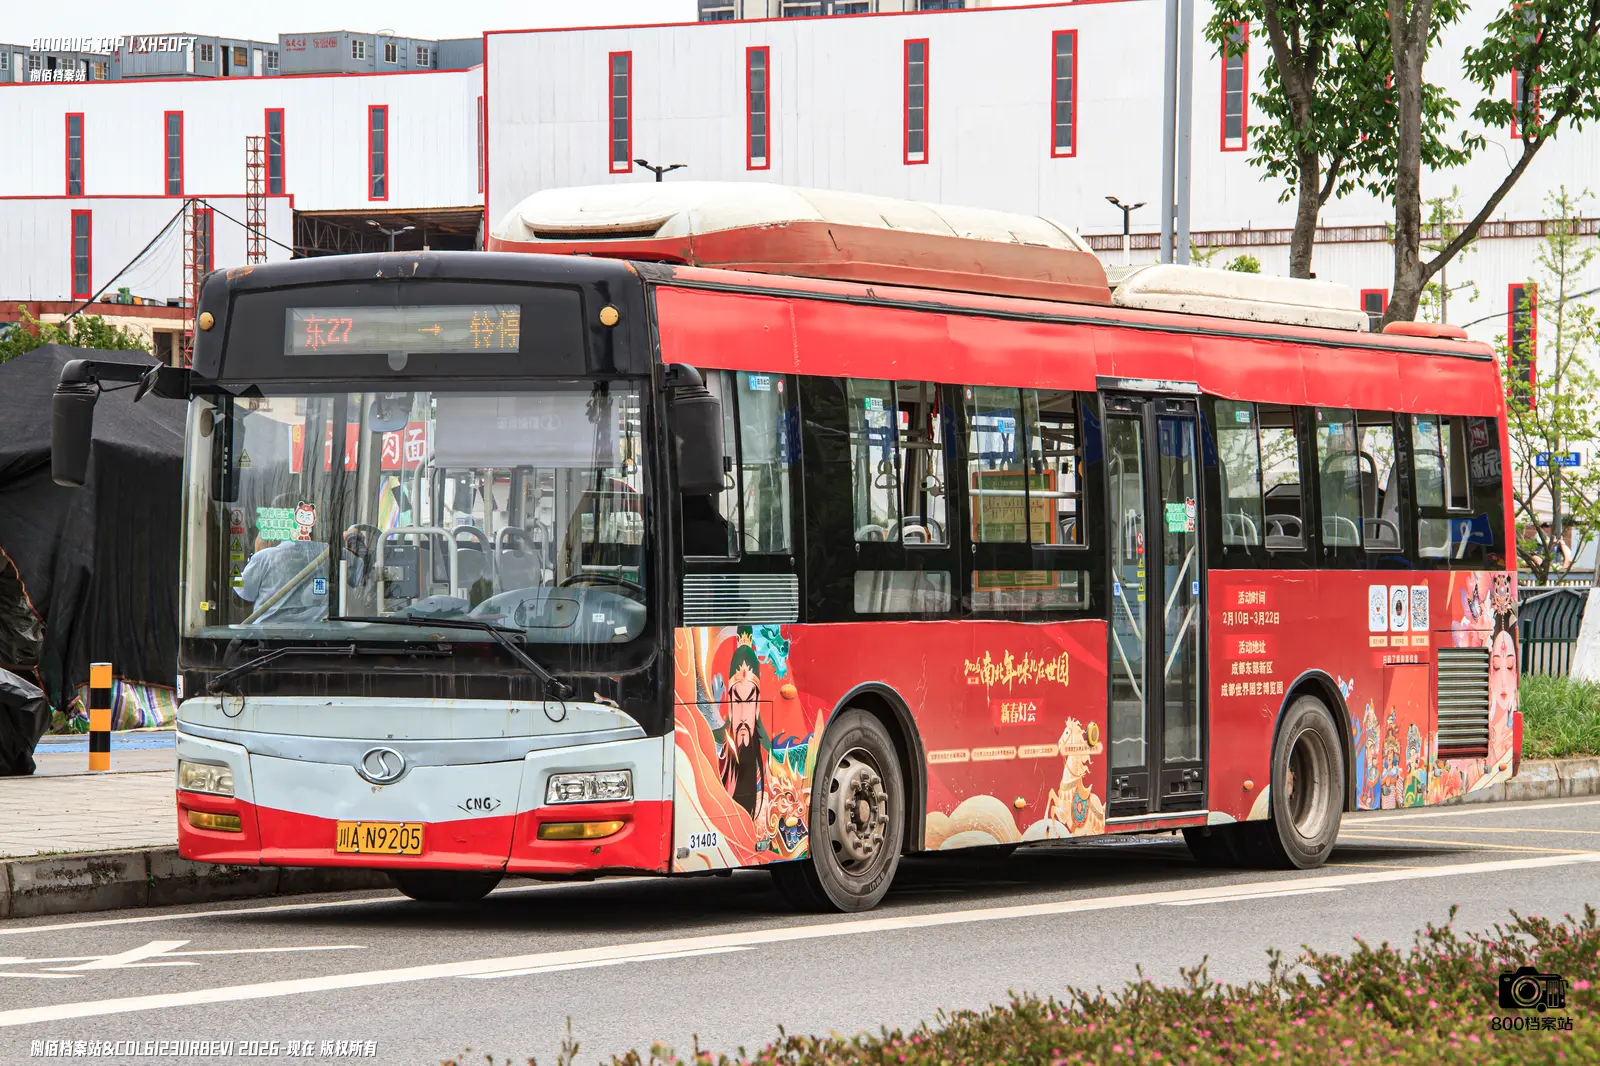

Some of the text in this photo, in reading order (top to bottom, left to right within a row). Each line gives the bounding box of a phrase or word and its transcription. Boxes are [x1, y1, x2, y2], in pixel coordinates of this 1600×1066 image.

[303, 310, 520, 350] 东27 铃停
[315, 579, 325, 591] 推
[1238, 591, 1266, 604] 活动时间
[1223, 611, 1280, 626] 2月10日-3月22日
[1238, 640, 1266, 654] 活动地址
[1231, 661, 1273, 675] 成都东部新区
[1221, 681, 1284, 697] 成都世界园艺博览园
[1001, 702, 1037, 723] 新春灯会
[465, 797, 491, 810] CNG
[690, 832, 717, 849] 31403
